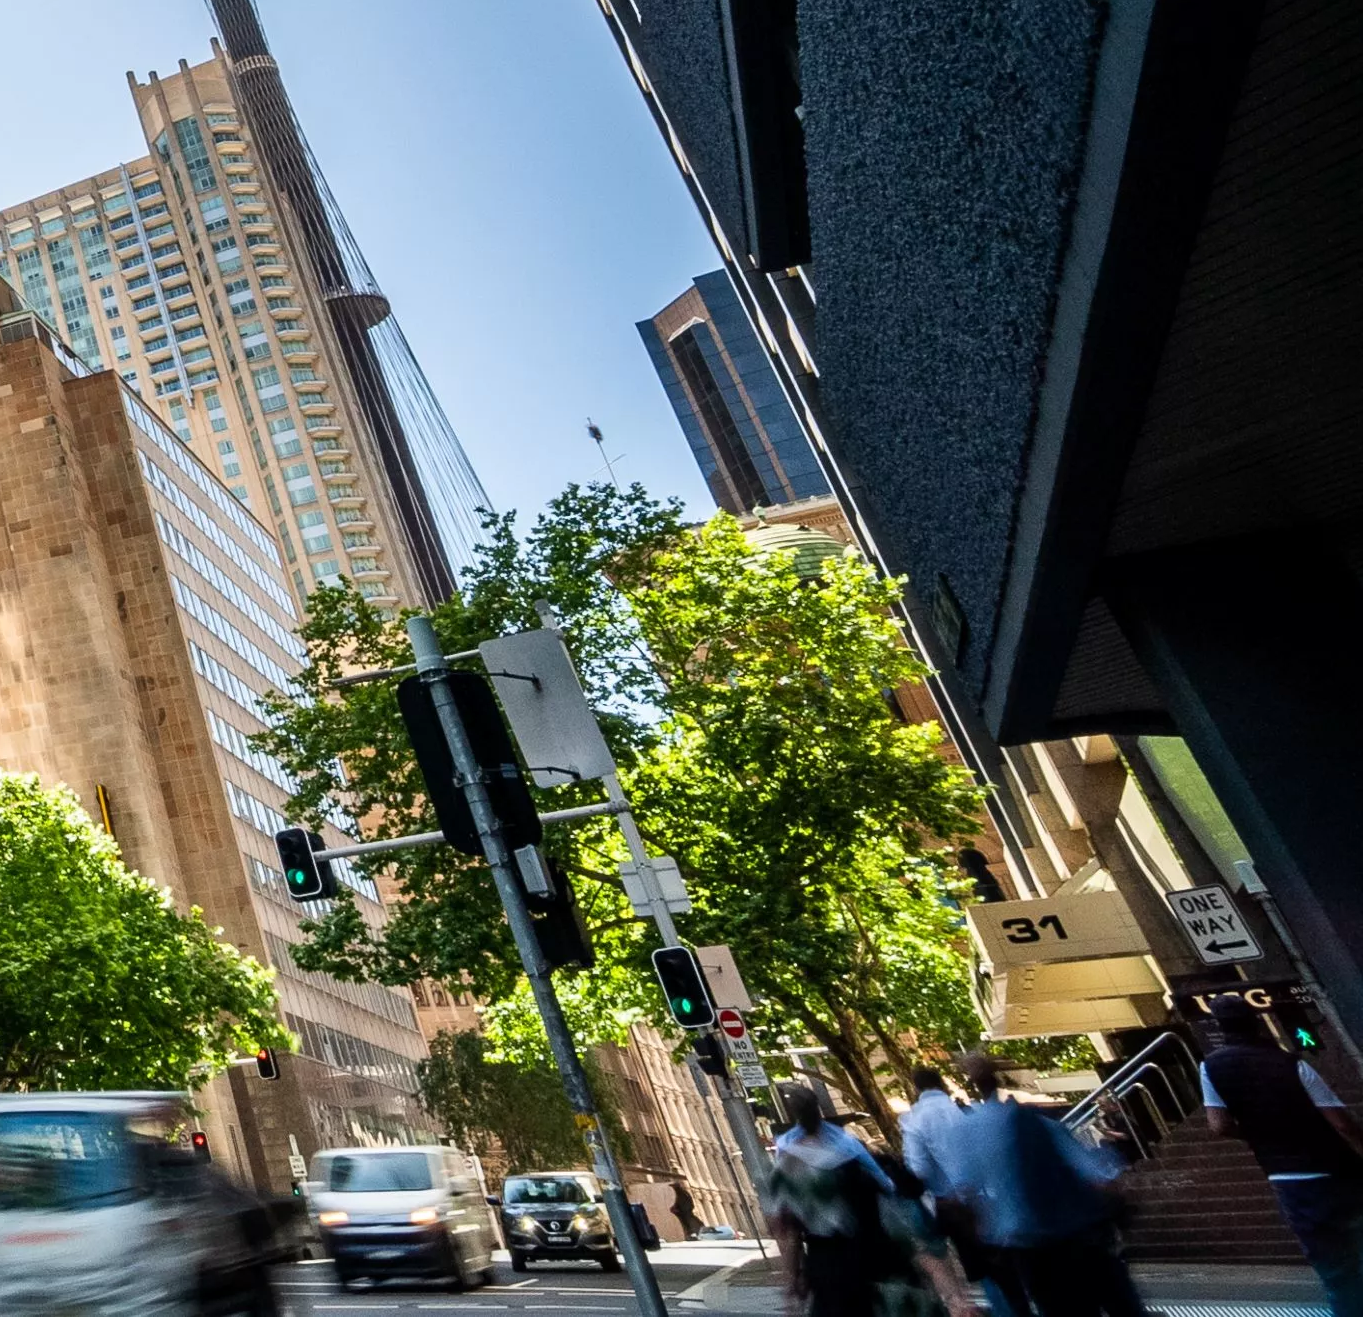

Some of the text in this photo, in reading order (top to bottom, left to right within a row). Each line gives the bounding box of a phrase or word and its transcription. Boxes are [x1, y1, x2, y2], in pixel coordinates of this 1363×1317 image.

[1179, 893, 1224, 914] ONE
[1002, 914, 1068, 944] 31
[1187, 914, 1236, 937] WAY
[733, 1041, 748, 1050] NO
